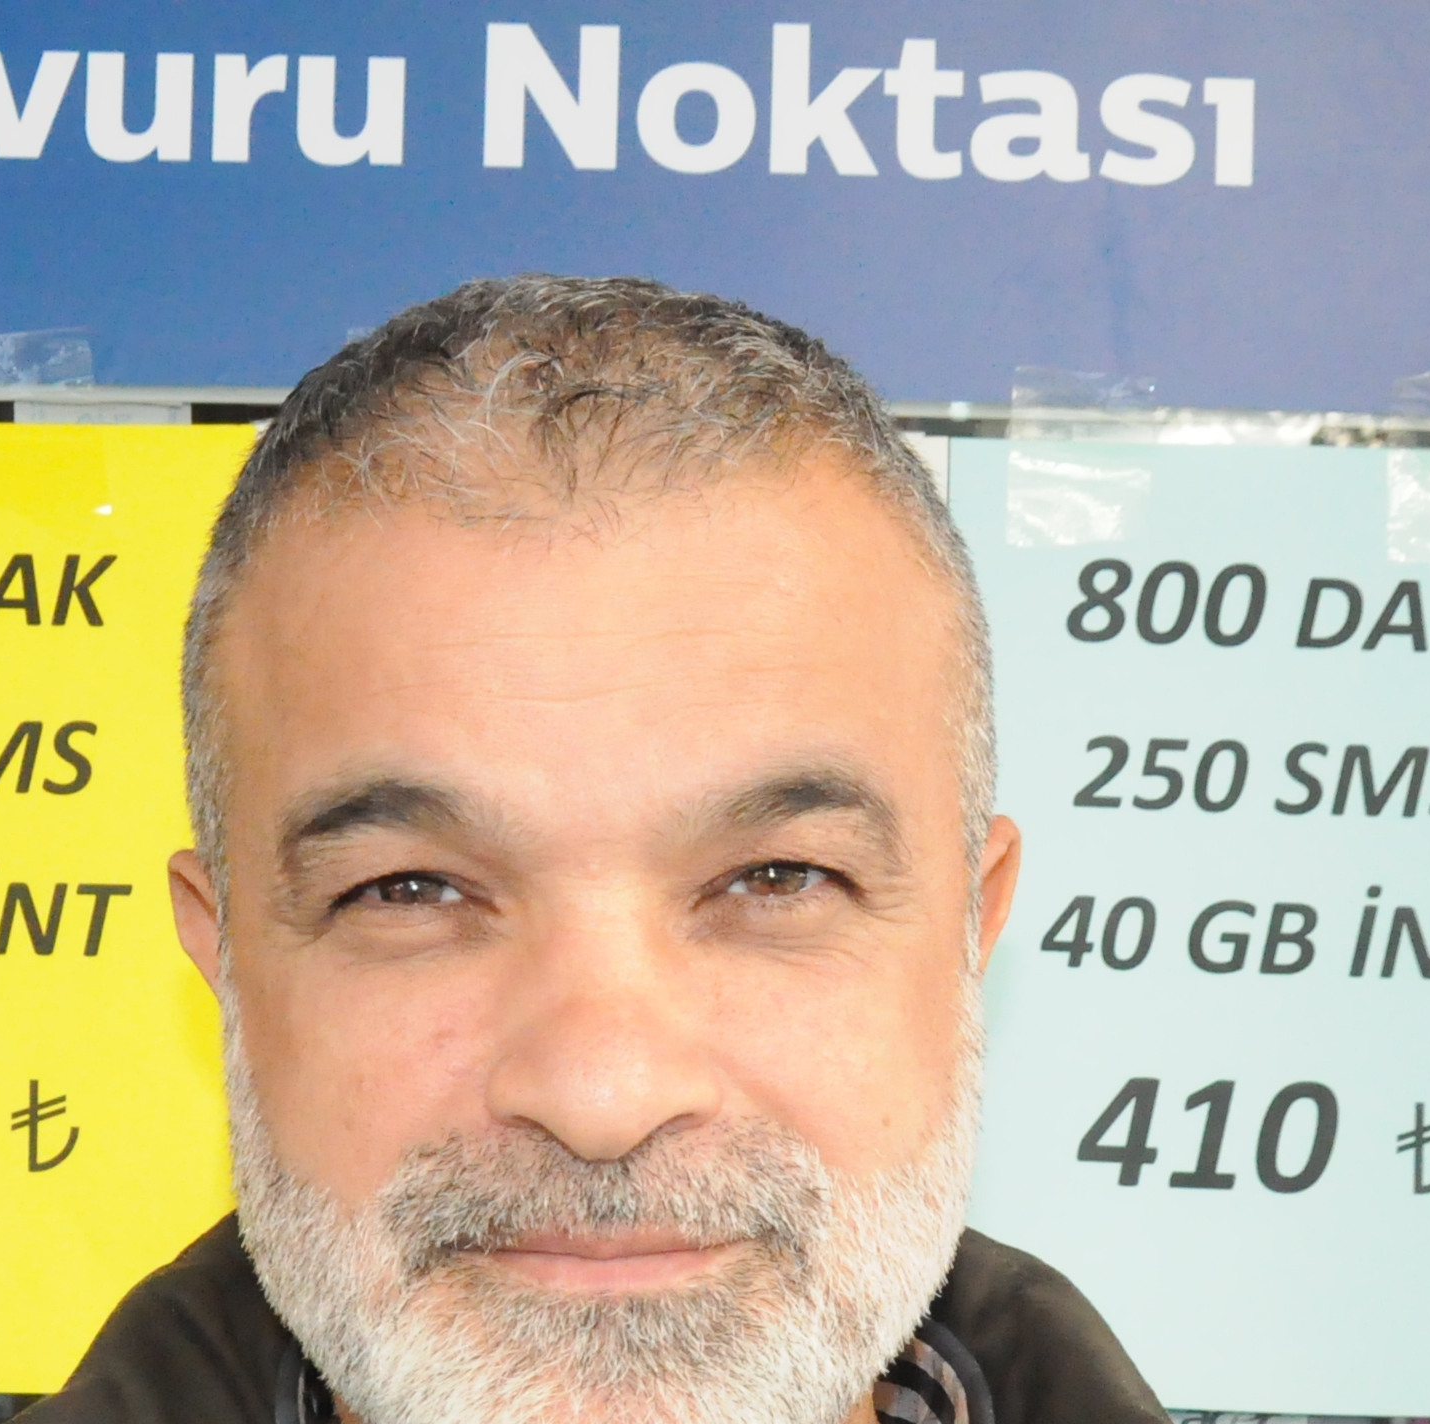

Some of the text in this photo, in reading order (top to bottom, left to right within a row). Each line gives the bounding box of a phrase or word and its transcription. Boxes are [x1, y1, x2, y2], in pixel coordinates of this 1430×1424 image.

[483, 22, 1257, 188] Noktası
[1066, 558, 1267, 648] 800
[1073, 735, 1249, 813] 250
[1040, 895, 1157, 971] 40
[1187, 900, 1318, 975] GB
[1076, 1077, 1339, 1194] 410
